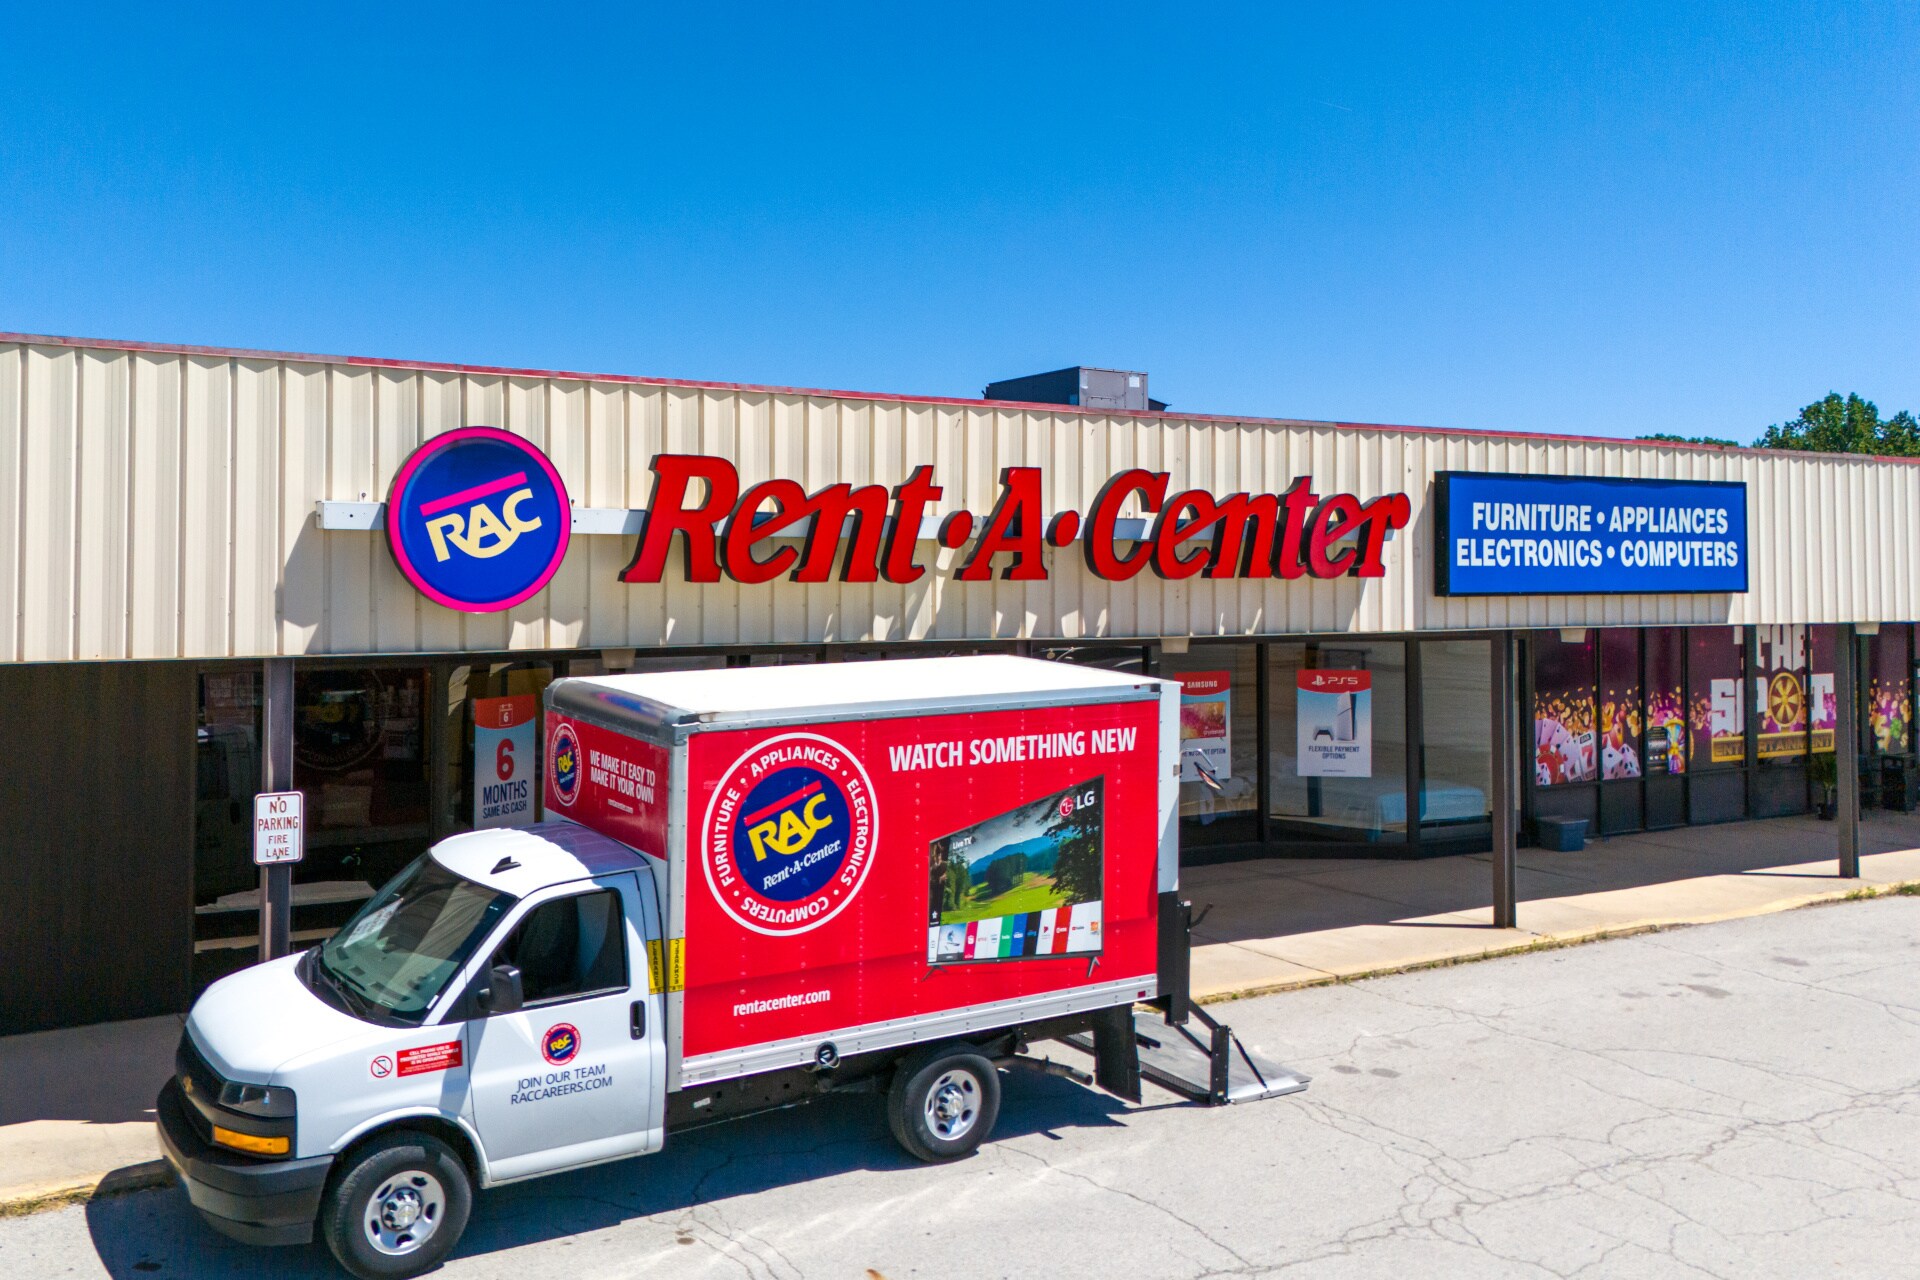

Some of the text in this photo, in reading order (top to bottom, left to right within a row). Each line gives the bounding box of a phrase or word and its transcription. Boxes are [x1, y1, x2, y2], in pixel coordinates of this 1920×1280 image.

[425, 488, 542, 562] RAC
[1472, 502, 1728, 534] FURNITURE APPLIANCES
[1456, 538, 1738, 567] ELECTRONICS COMPUTERS
[1187, 680, 1217, 688] SAMSUNG
[1327, 676, 1358, 685] PS5
[503, 712, 509, 723] 6
[496, 738, 515, 781] 6
[558, 751, 573, 772] RAC
[889, 727, 1137, 772] WATCH SOMETHING NEW
[590, 749, 655, 787] WE MAKE IT EASY TO
[483, 779, 528, 806] MONTHS
[590, 766, 608, 788] MAKE
[609, 773, 616, 790] IT
[617, 777, 635, 798] YOUR
[635, 784, 654, 805] OWN
[269, 800, 287, 813] NO
[483, 800, 527, 819] SAME AS CASH
[1077, 791, 1095, 810] LG
[258, 815, 299, 831] PARKING
[713, 746, 869, 923] FURNITURE APPLIANCES ELECTRONICS COMPUTERS
[747, 793, 833, 862] RAC
[266, 846, 290, 858] LANE
[268, 834, 288, 845] FIRE
[964, 836, 973, 845] TV
[733, 989, 831, 1017] rentacenter.com
[550, 1034, 571, 1051] RAC
[510, 1076, 613, 1105] RACCAREERS.COM
[517, 1064, 605, 1093] JOIN OUR TEAM
